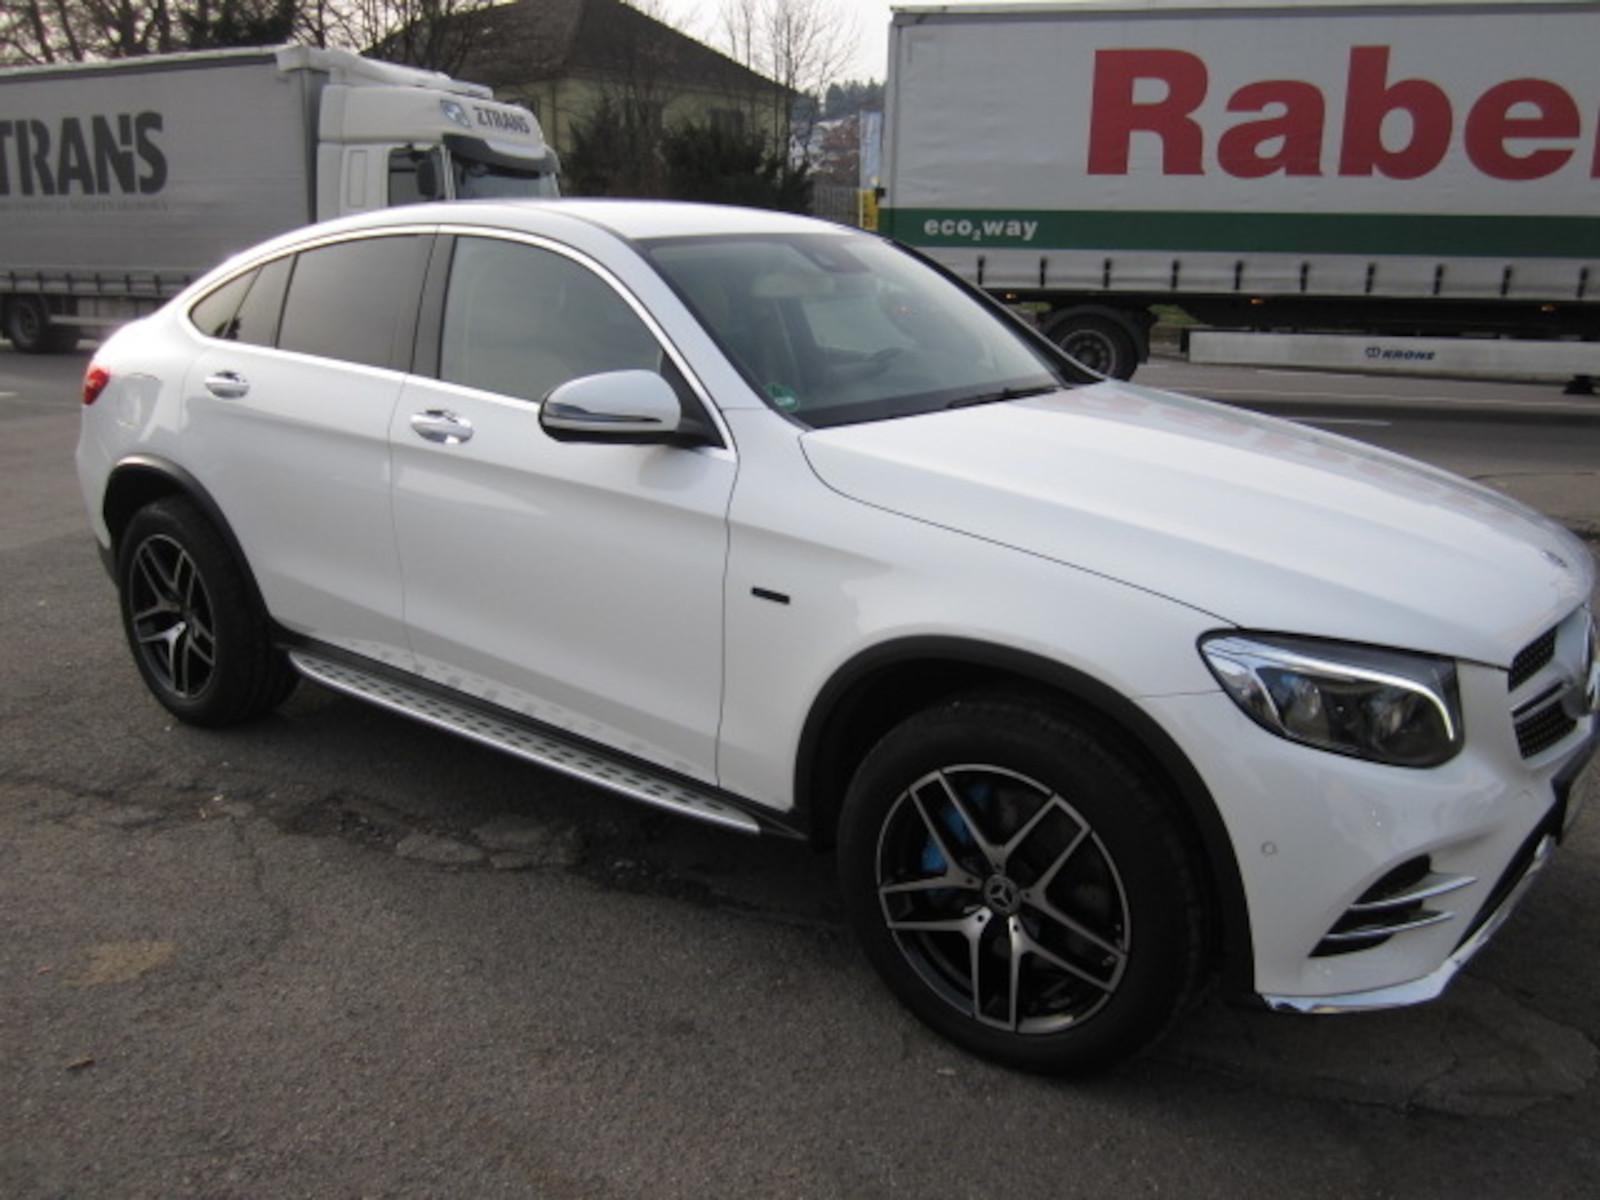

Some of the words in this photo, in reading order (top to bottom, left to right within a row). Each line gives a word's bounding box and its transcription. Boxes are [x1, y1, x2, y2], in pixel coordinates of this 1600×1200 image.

[473, 106, 530, 134] ZTRANS
[1086, 45, 1600, 181] Rabe
[1382, 350, 1435, 361] KRONE
